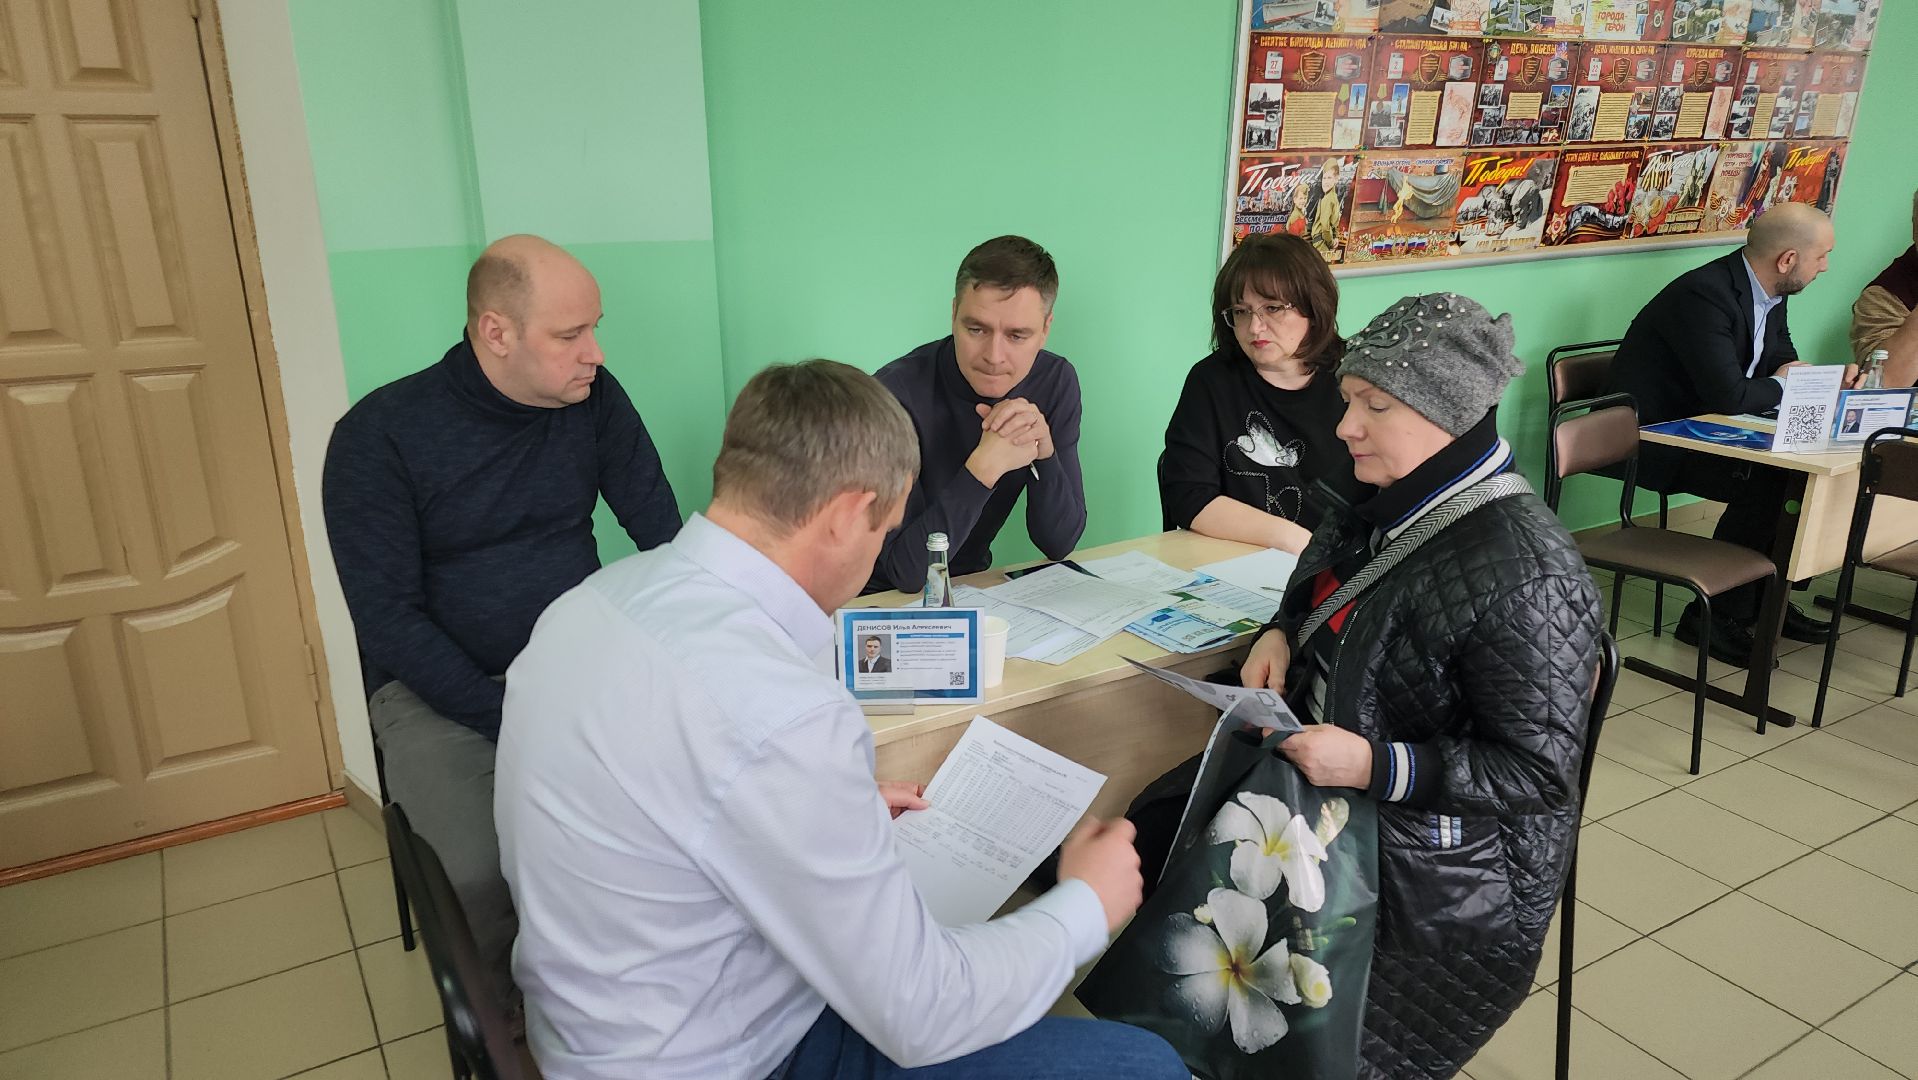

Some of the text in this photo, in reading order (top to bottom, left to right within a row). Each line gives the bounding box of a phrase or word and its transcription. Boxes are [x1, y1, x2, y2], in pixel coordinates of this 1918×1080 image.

[1510, 43, 1528, 55] ДЕНЬ
[1270, 60, 1278, 69] 27
[1463, 156, 1536, 193] Победа!
[1240, 162, 1324, 203] Победа!
[857, 624, 892, 632] ДЕНИСОВ
